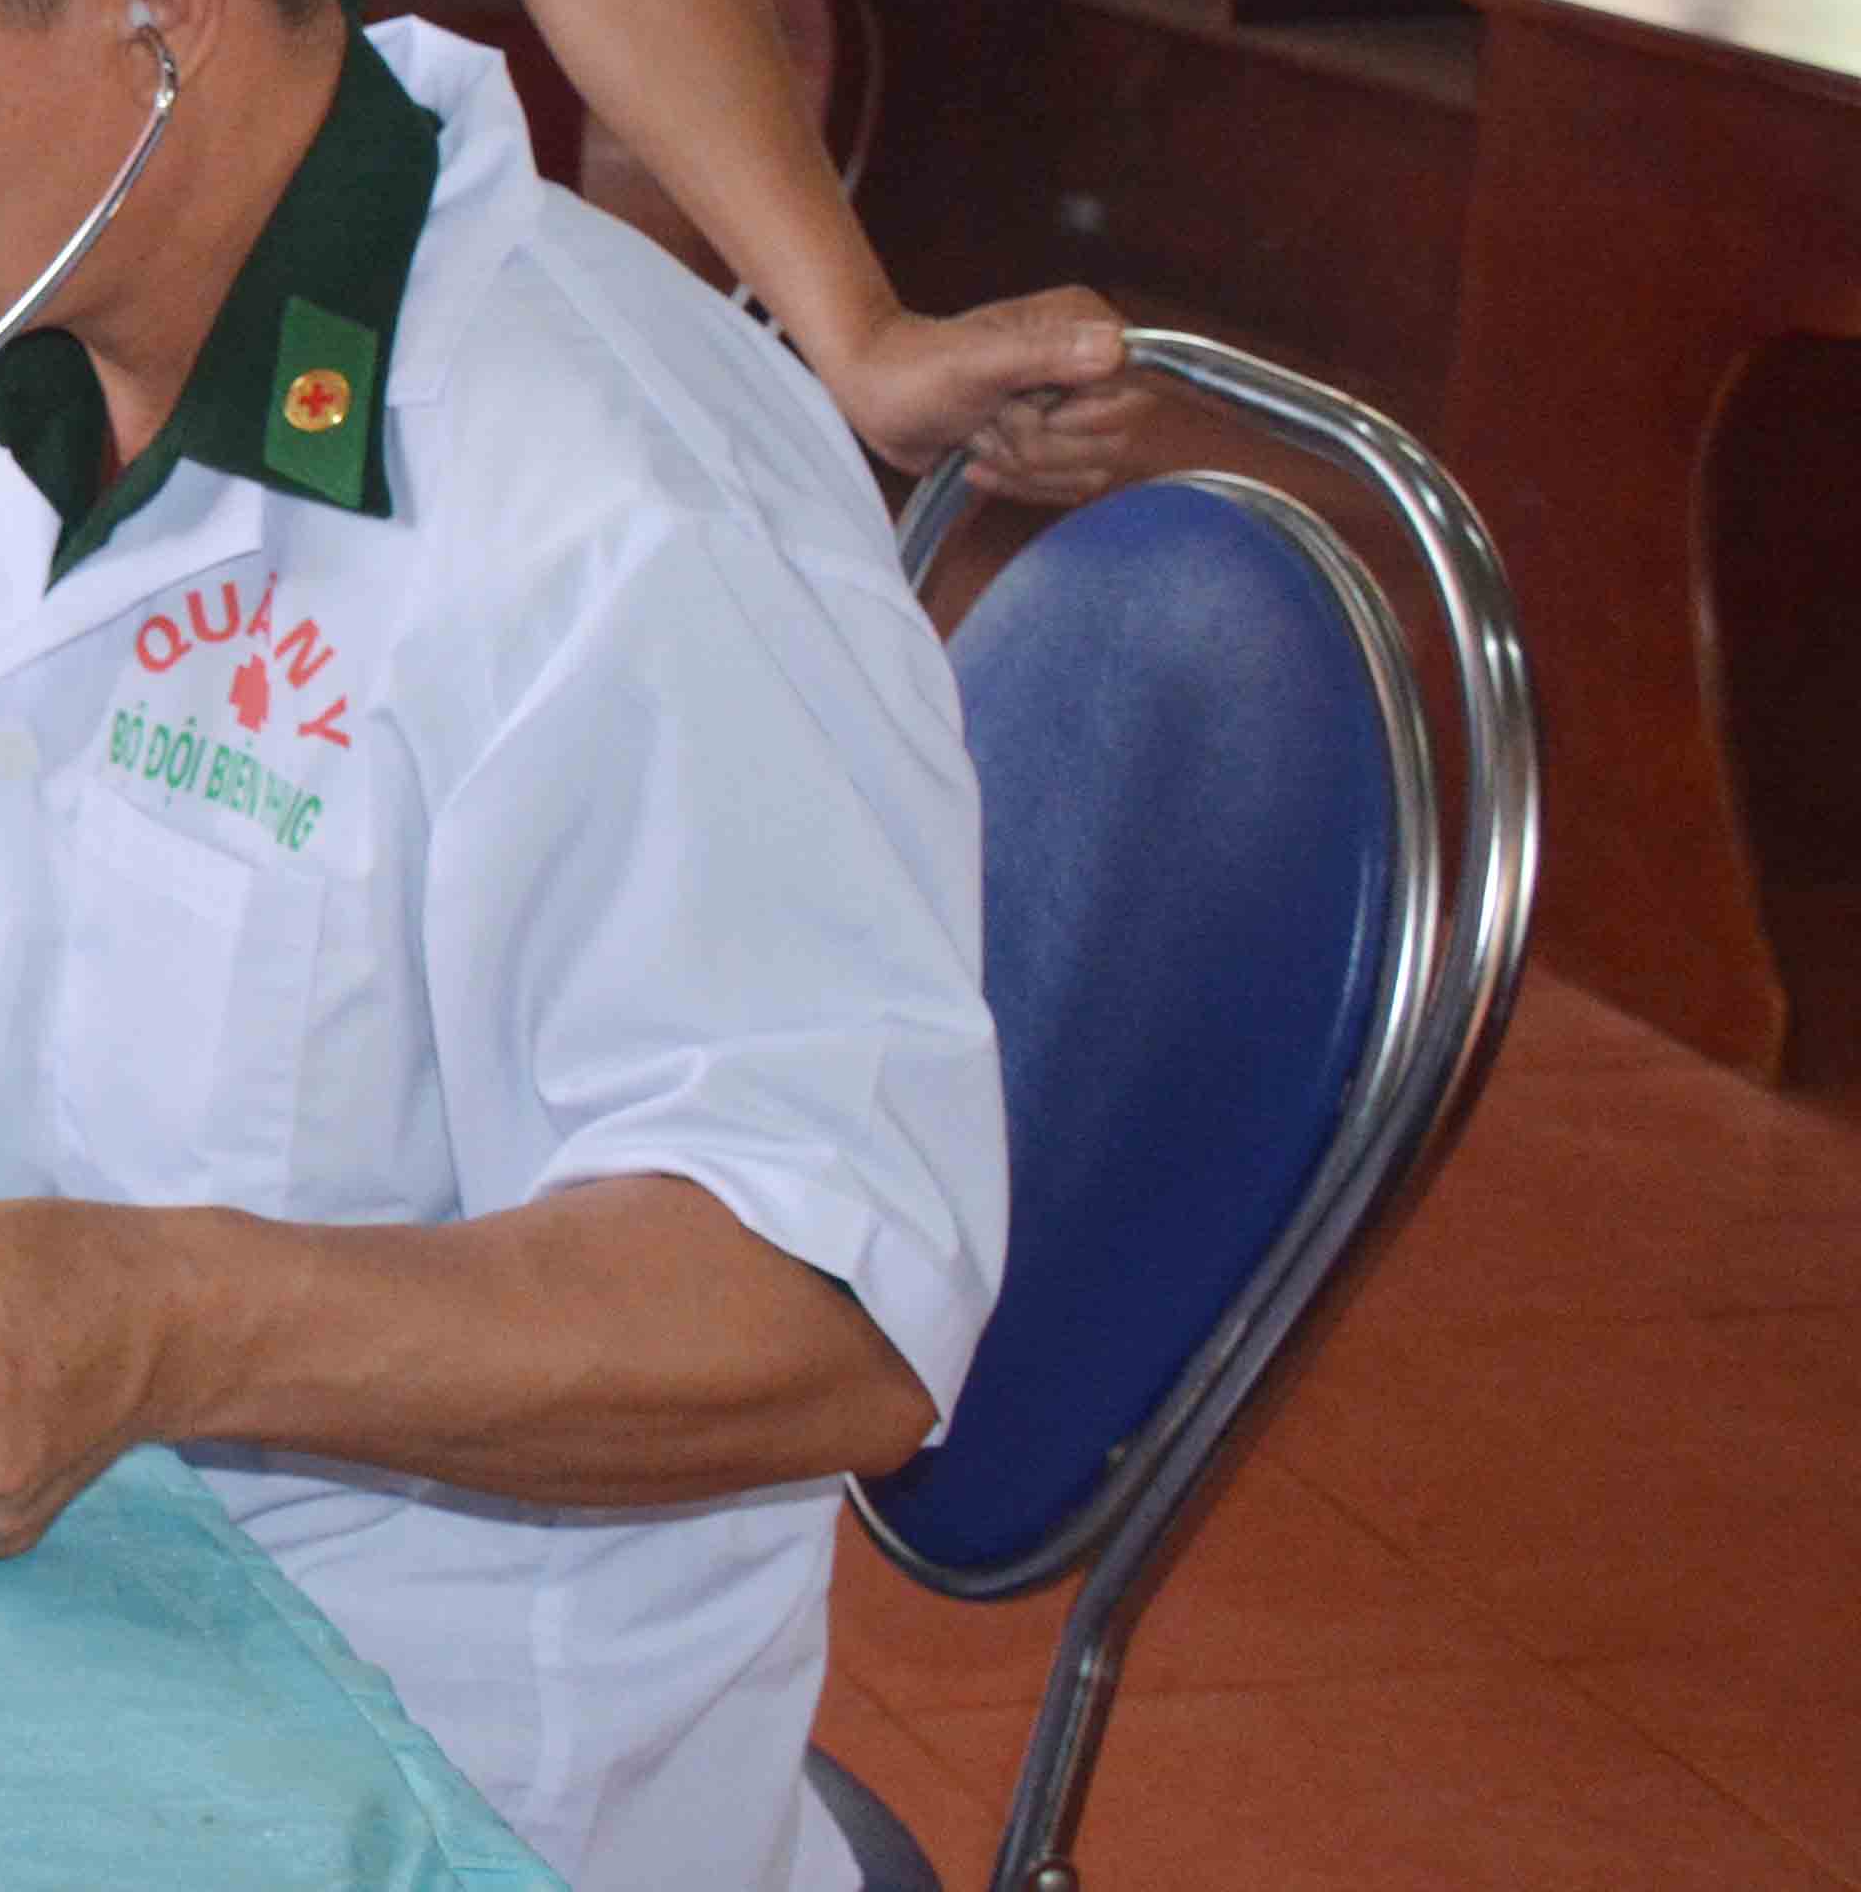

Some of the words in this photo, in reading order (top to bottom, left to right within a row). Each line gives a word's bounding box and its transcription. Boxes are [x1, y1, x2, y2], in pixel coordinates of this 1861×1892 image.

[135, 571, 337, 690] QUÂN
[297, 692, 353, 750] Y
[143, 714, 209, 807] ĐỘI
